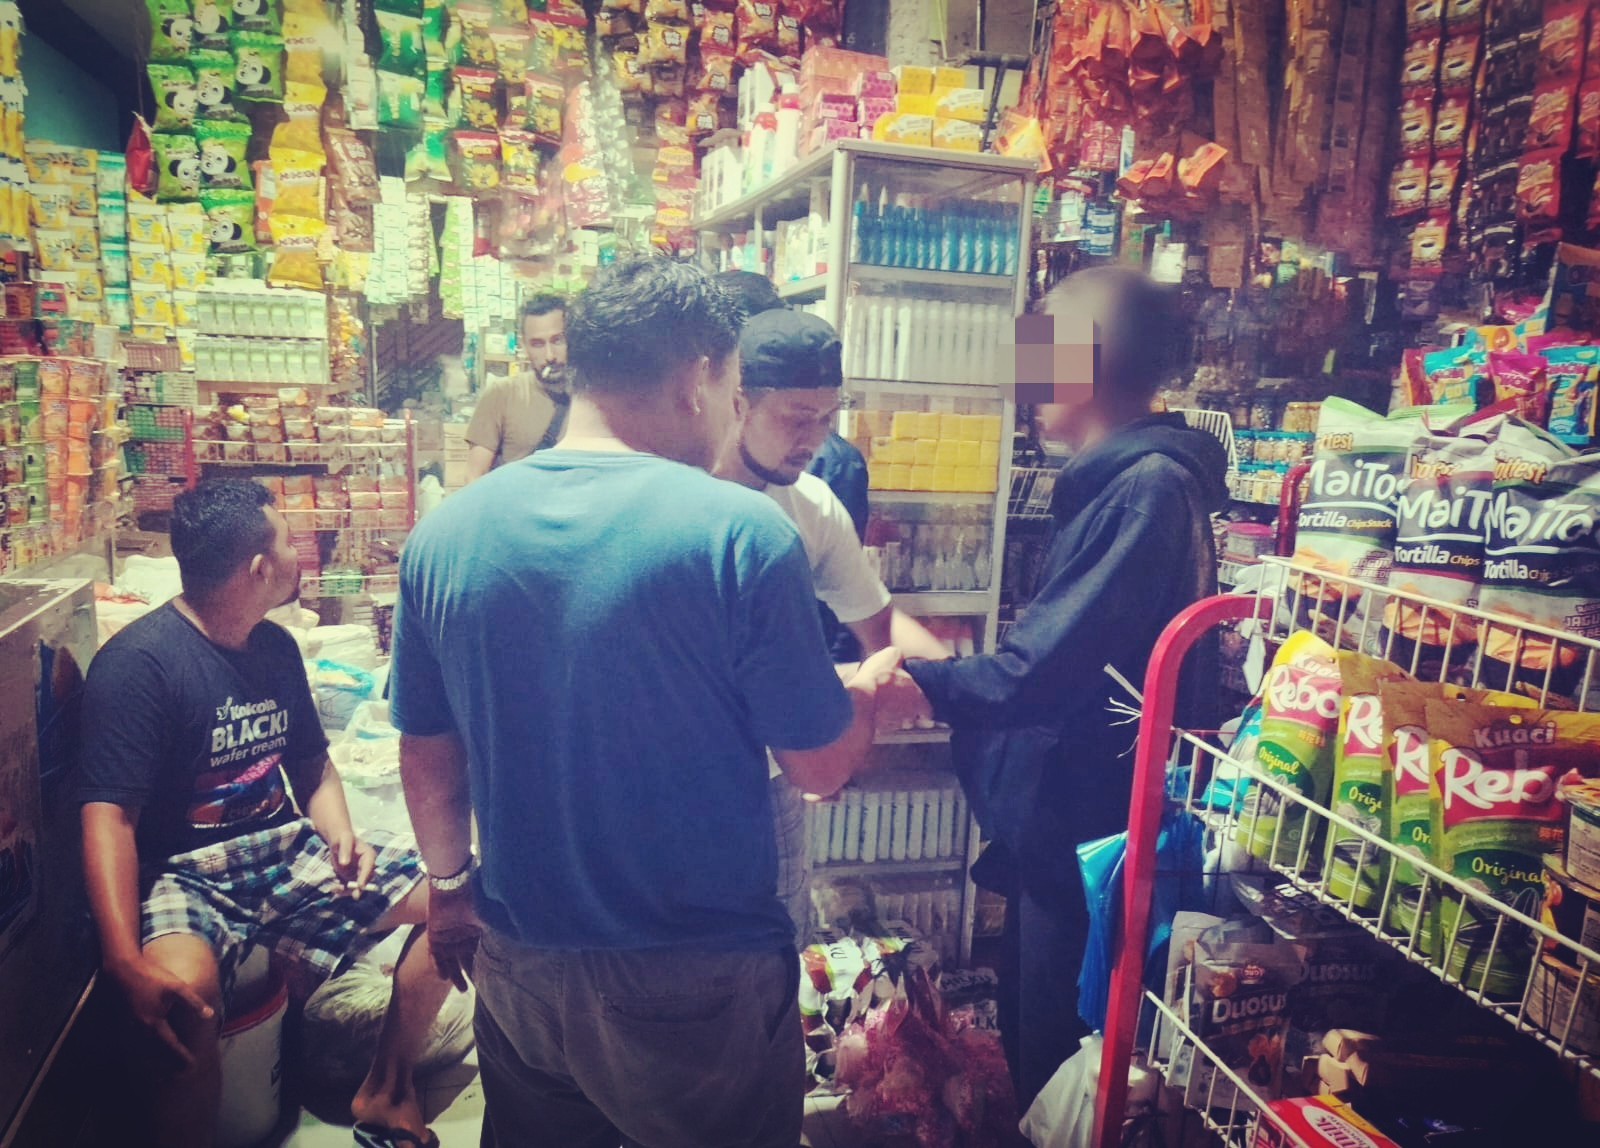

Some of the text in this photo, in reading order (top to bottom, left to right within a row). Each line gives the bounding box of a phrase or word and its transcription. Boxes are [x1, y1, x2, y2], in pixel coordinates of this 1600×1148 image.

[1297, 511, 1348, 528] ortilla
[1396, 486, 1493, 531] MaiT
[1394, 545, 1451, 564] Tortilla
[1450, 555, 1481, 567] Chips
[1483, 558, 1529, 580] Tortilla
[1269, 664, 1341, 719] Rebo
[211, 709, 288, 753] BLACK!
[1472, 722, 1556, 748] Kuaci
[210, 736, 287, 768] wafer cream
[1259, 746, 1300, 775] Original
[1471, 857, 1548, 885] Original
